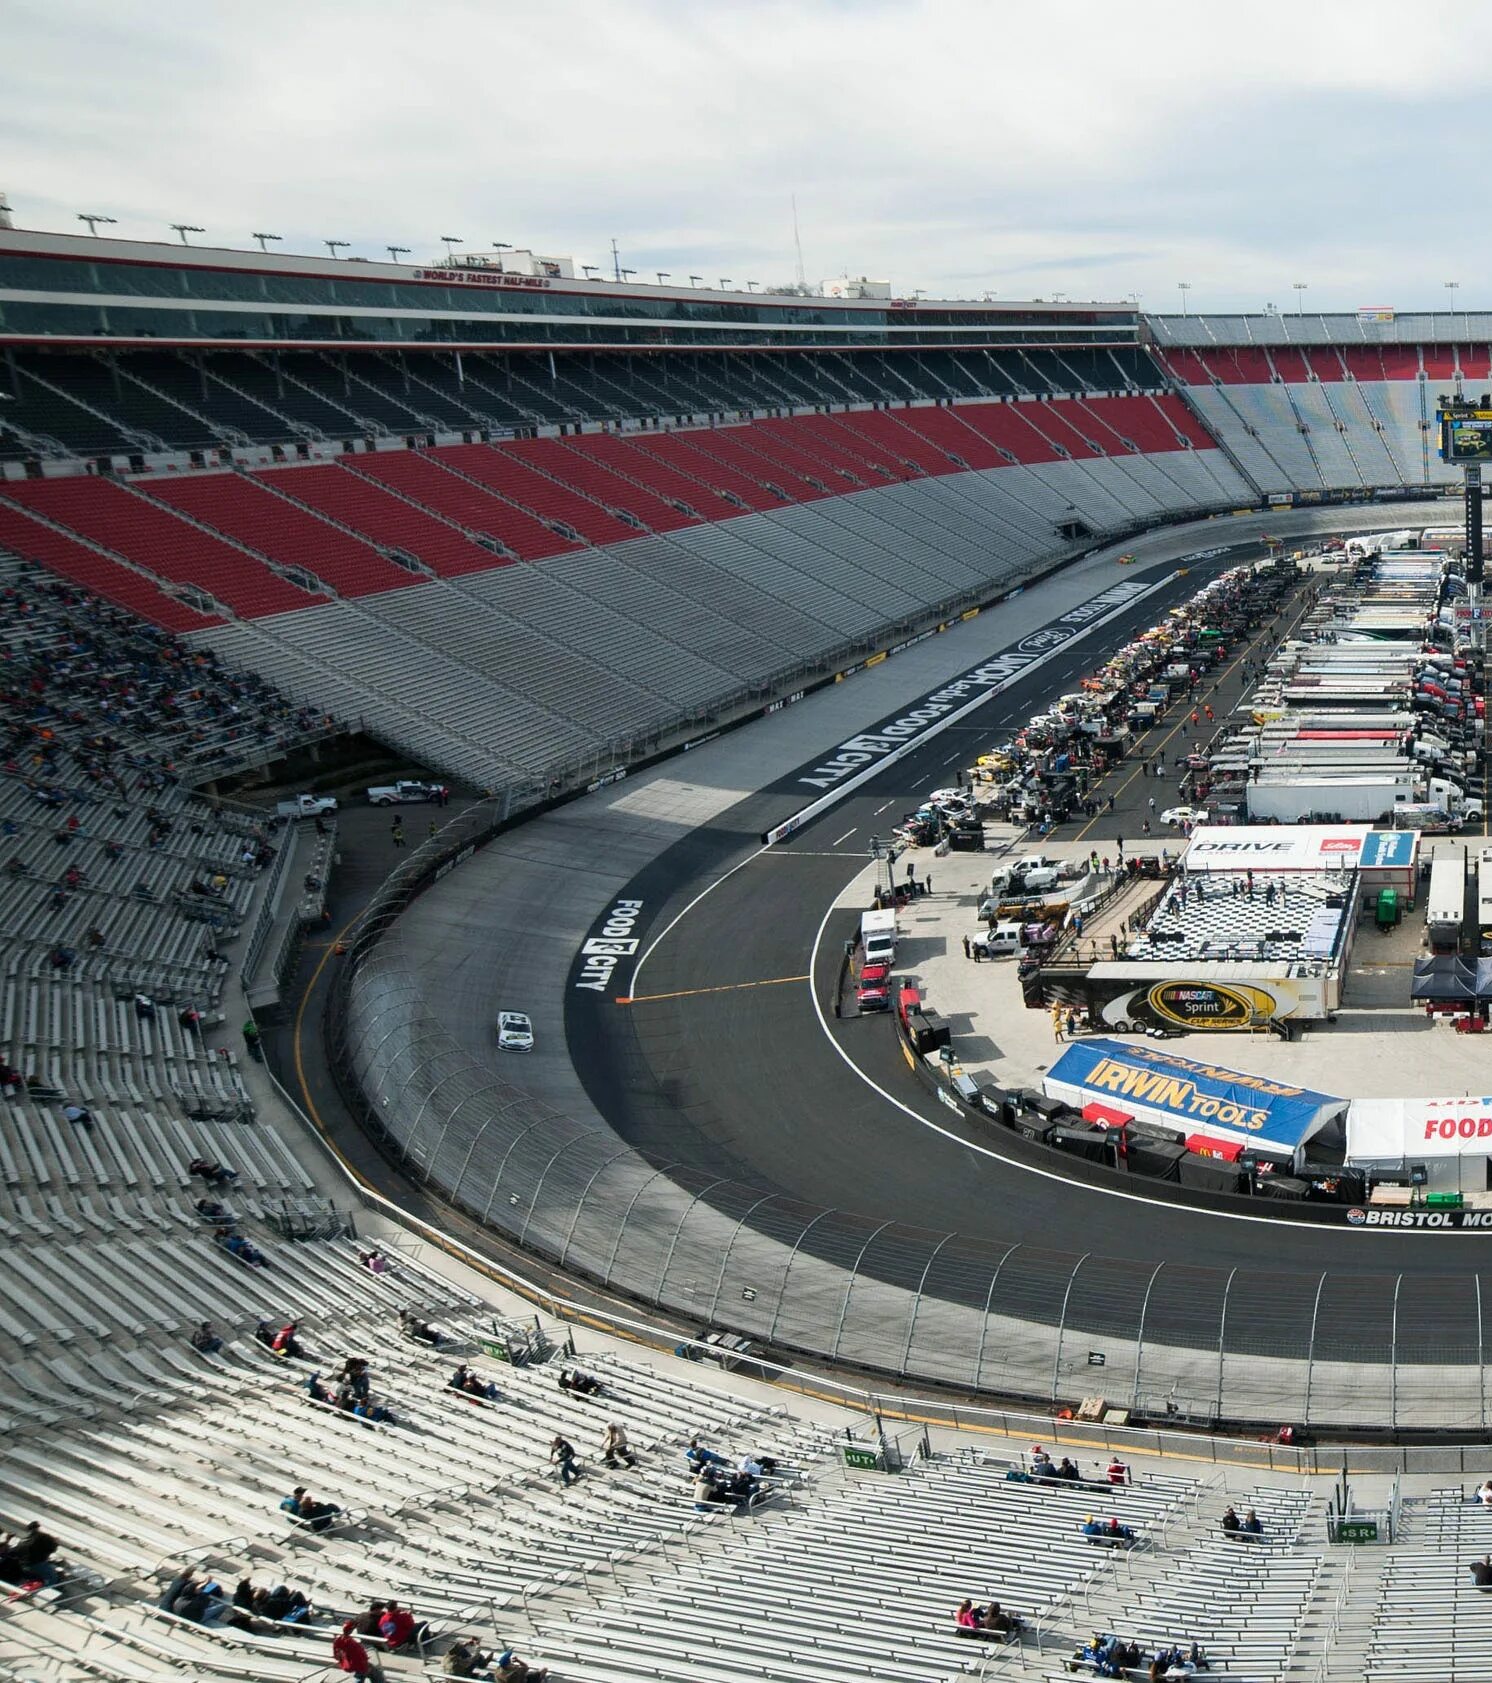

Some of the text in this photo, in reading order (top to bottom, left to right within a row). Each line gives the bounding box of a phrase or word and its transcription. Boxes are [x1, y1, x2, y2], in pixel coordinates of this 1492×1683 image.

[423, 269, 544, 287] WORLD'S FASTEST HALF-MILE
[799, 703, 953, 788] FOOD CITY
[1194, 843, 1295, 851] DRIVE
[575, 899, 643, 992] FOOD CITY
[1179, 991, 1214, 1000] NASCAR
[1185, 1002, 1220, 1013] Sprint
[1084, 1061, 1268, 1131] IRWIN TOOLS
[1365, 1211, 1455, 1227] BRISTOL
